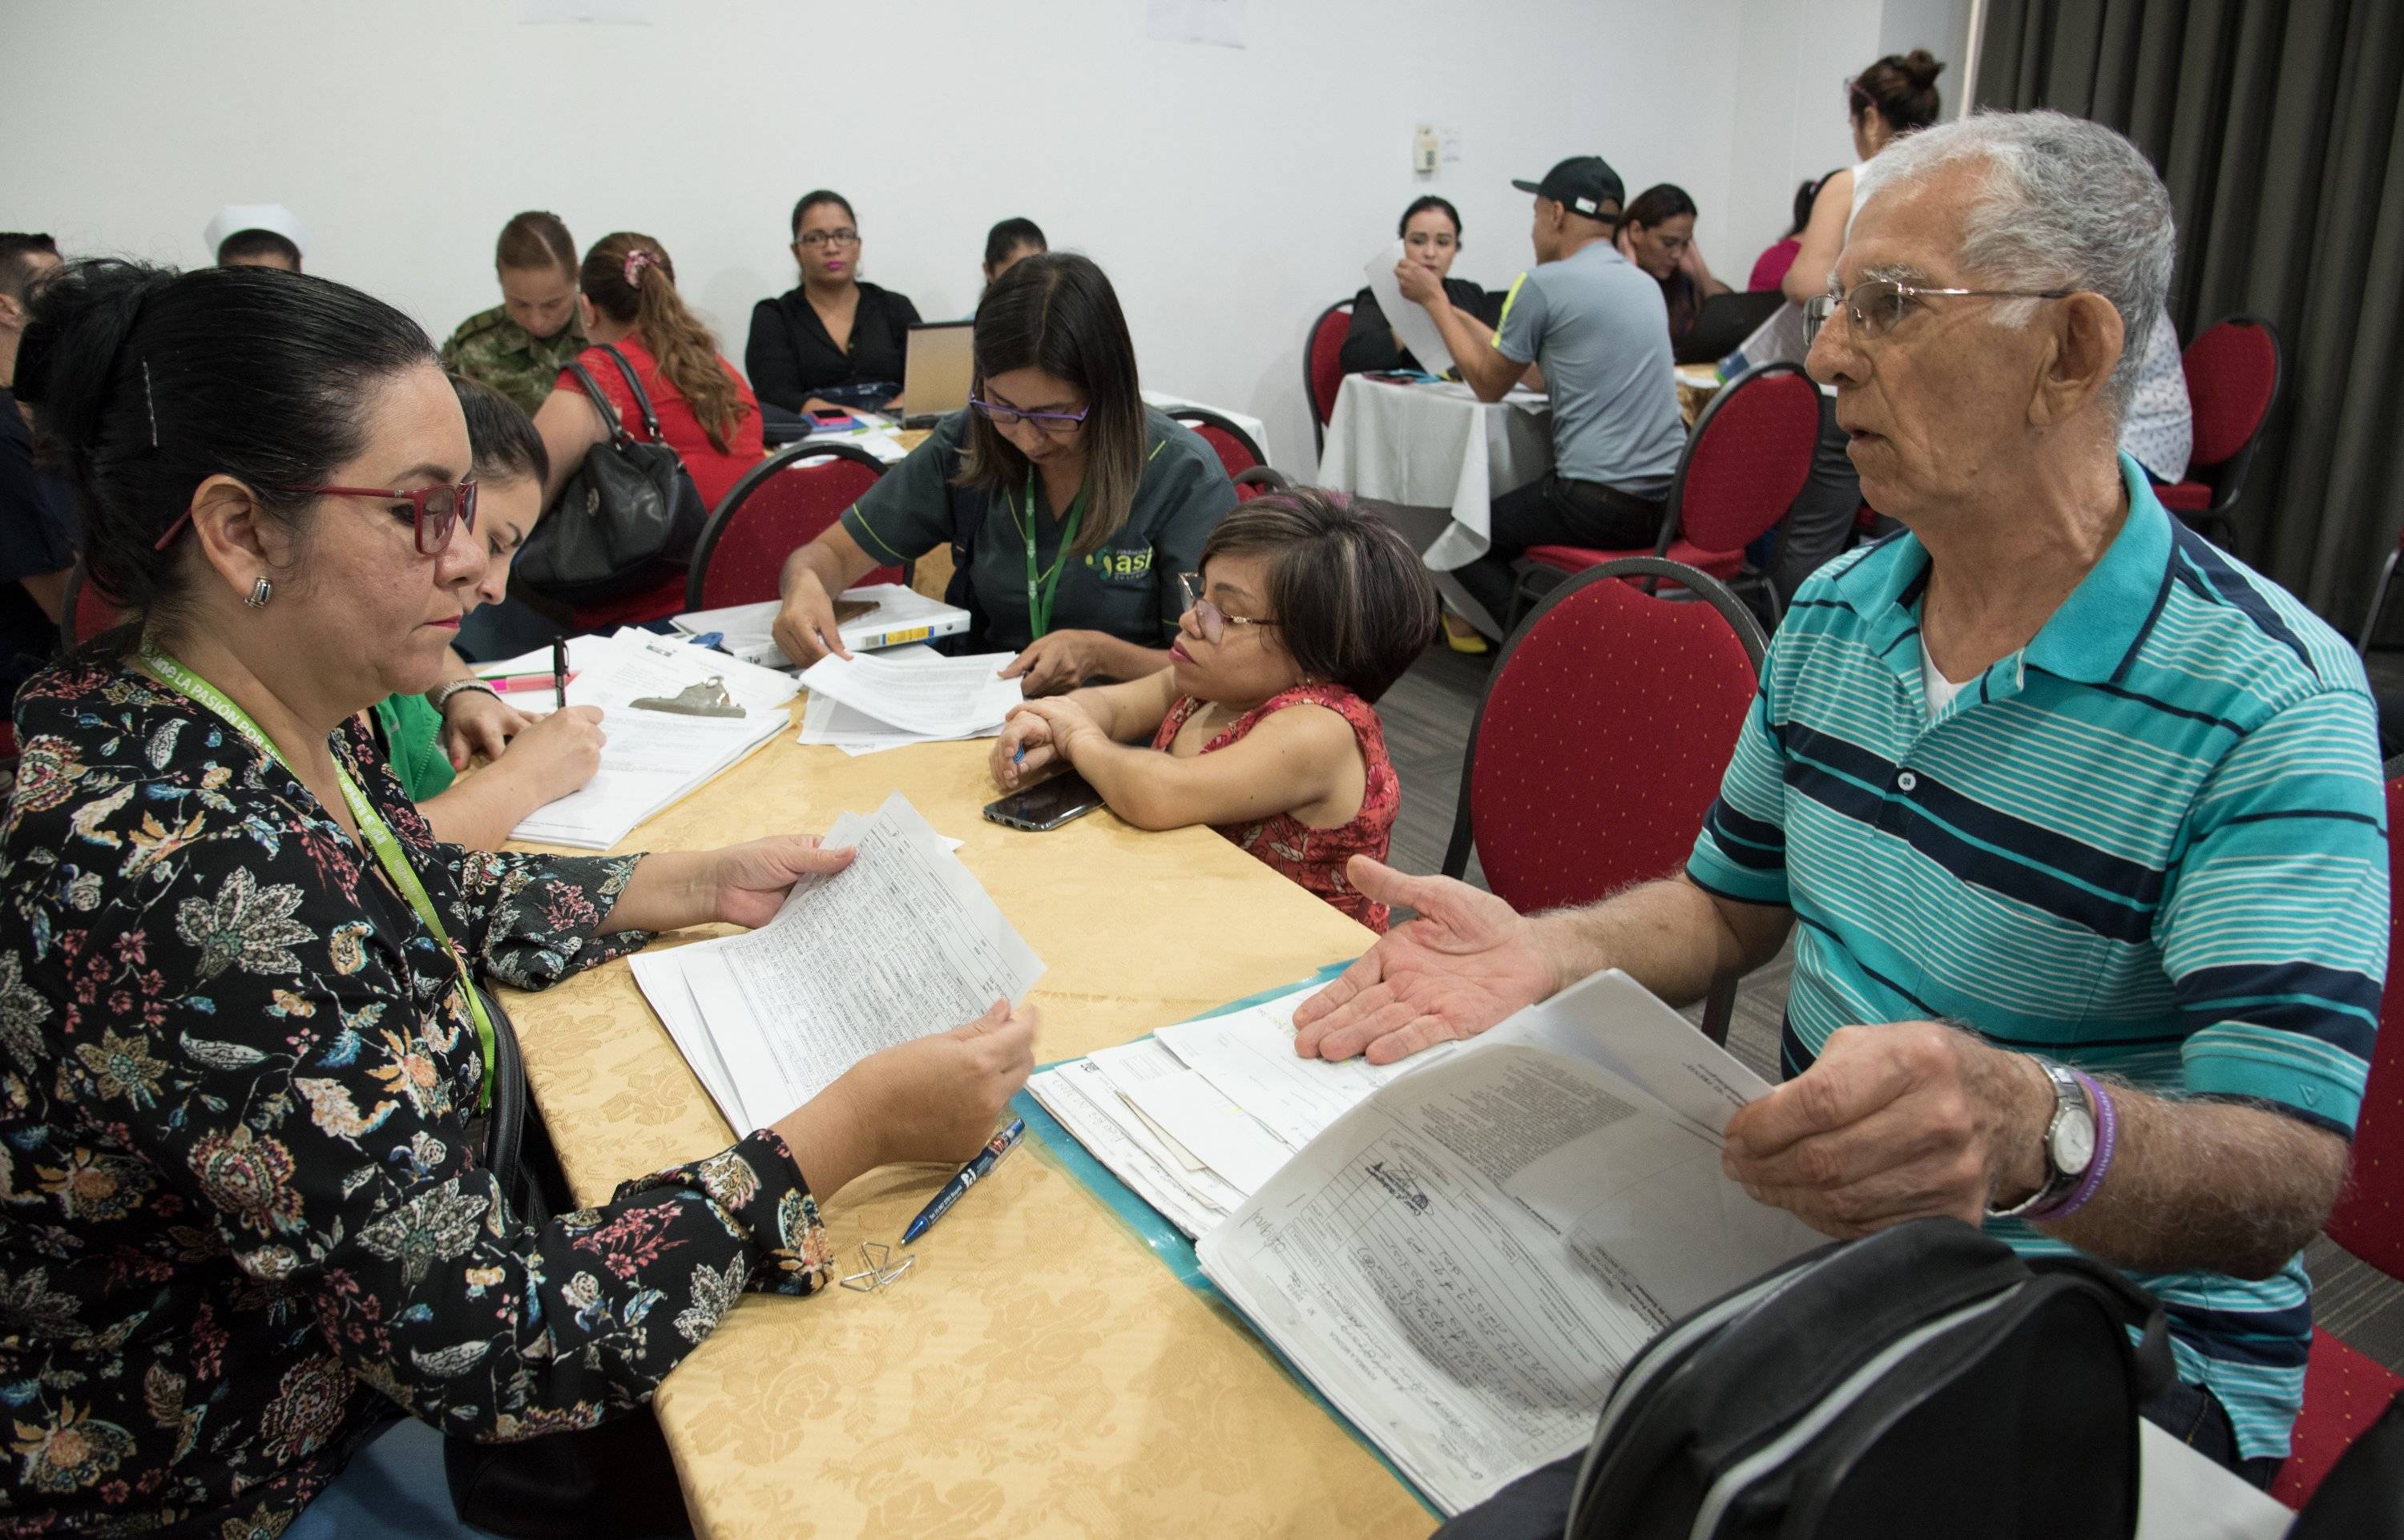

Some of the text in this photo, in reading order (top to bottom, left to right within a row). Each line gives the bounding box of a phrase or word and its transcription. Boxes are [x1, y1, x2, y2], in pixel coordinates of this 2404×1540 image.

[174, 673, 191, 691] LA
[190, 683, 240, 725] PASIÓN
[236, 721, 264, 748] POR
